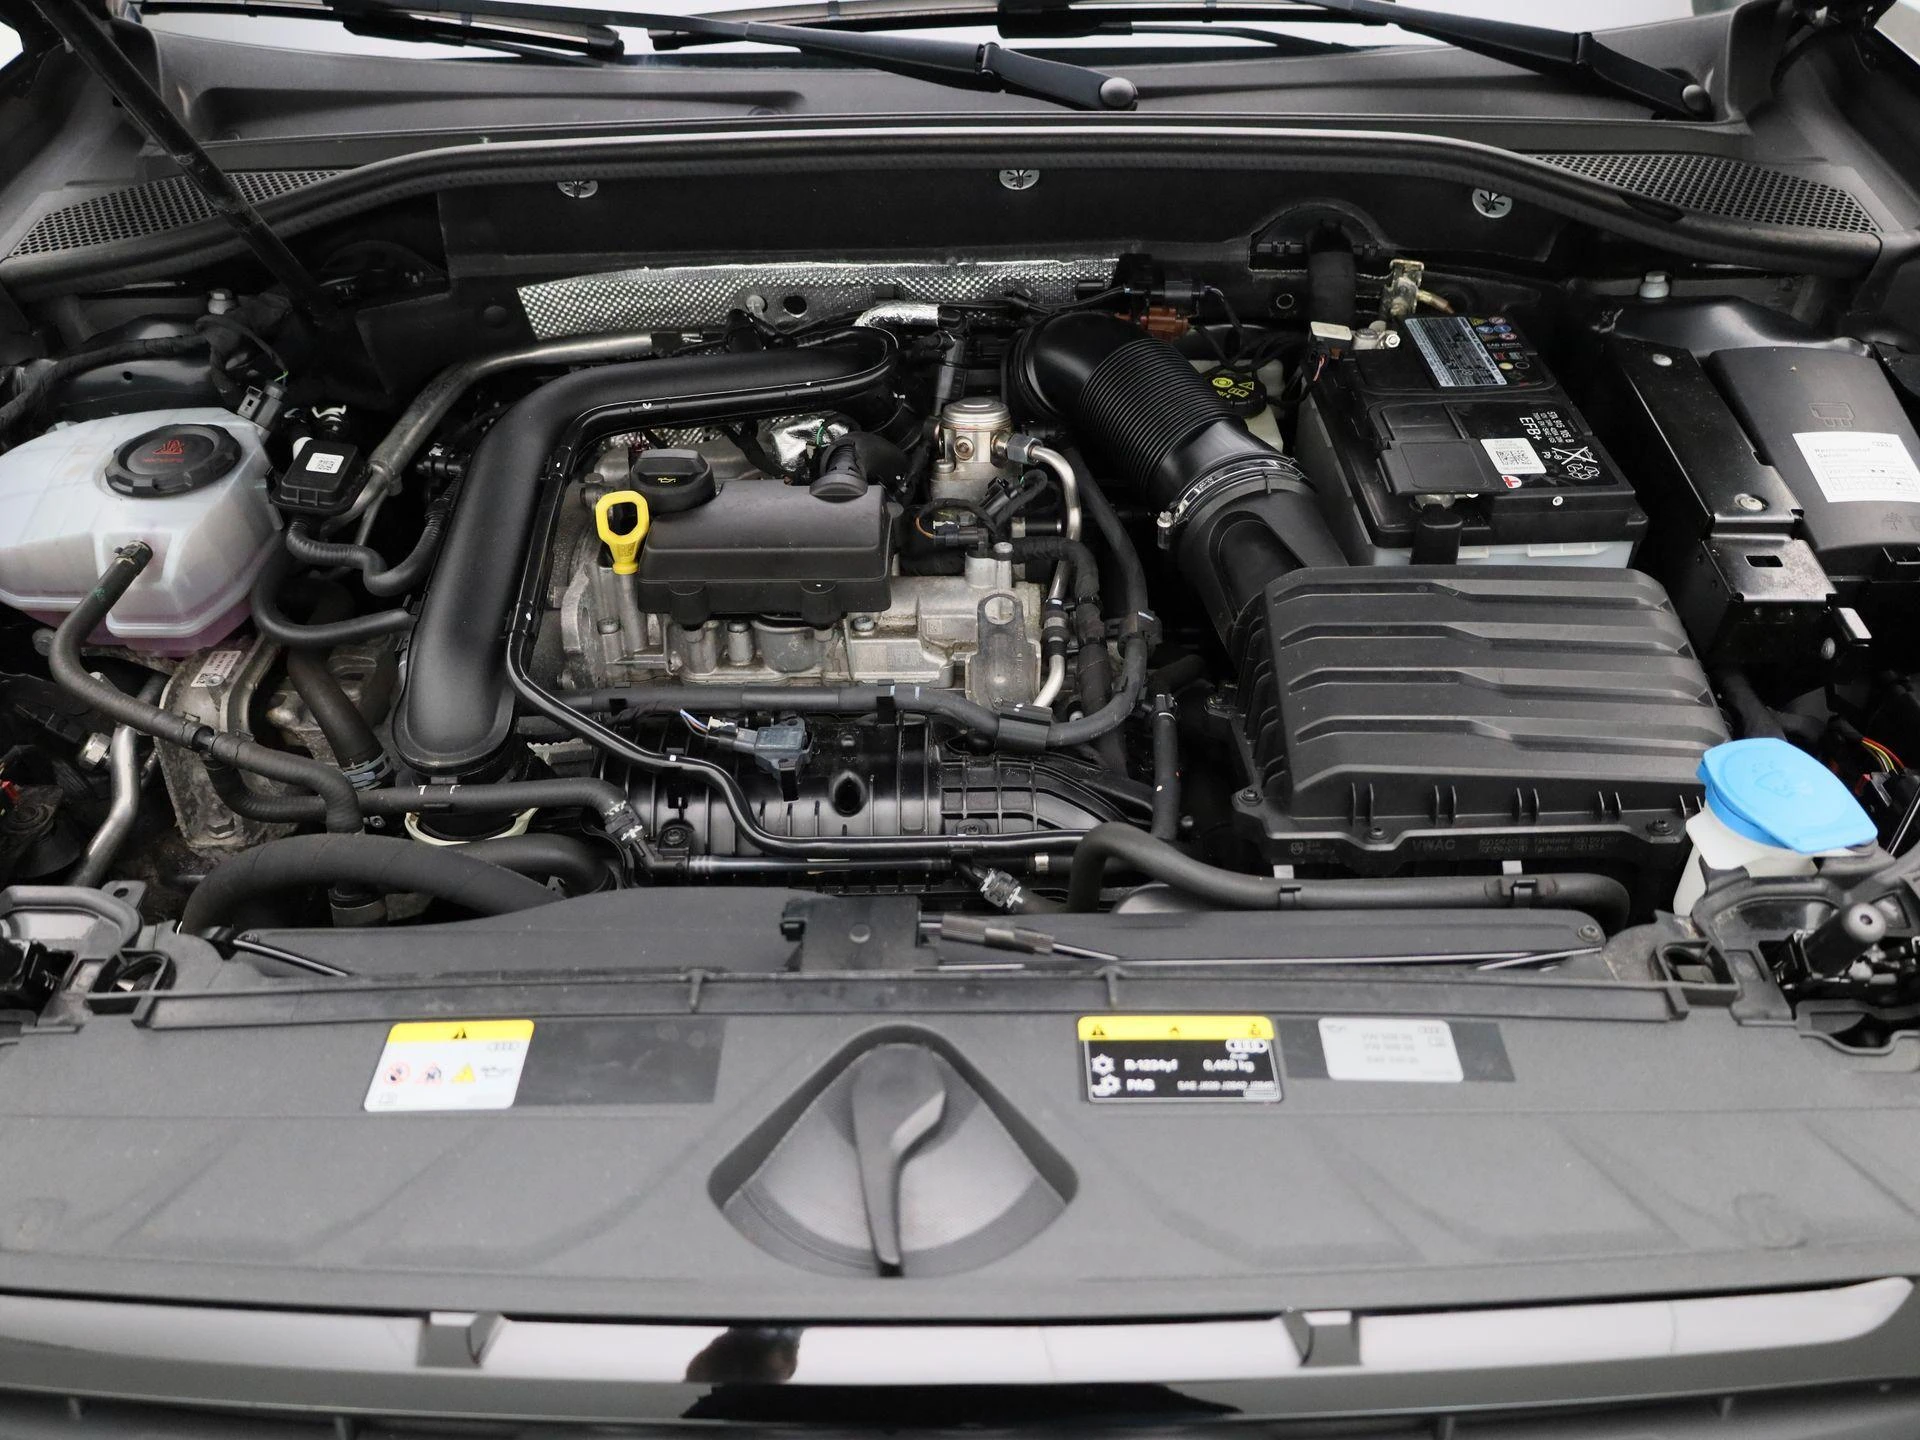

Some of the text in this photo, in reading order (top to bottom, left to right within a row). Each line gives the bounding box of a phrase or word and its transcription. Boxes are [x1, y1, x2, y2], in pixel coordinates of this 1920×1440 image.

[1519, 417, 1542, 440] EFB+
[1412, 838, 1456, 851] VWAG
[1238, 1058, 1256, 1074] kg
[1126, 1078, 1156, 1092] PAG
